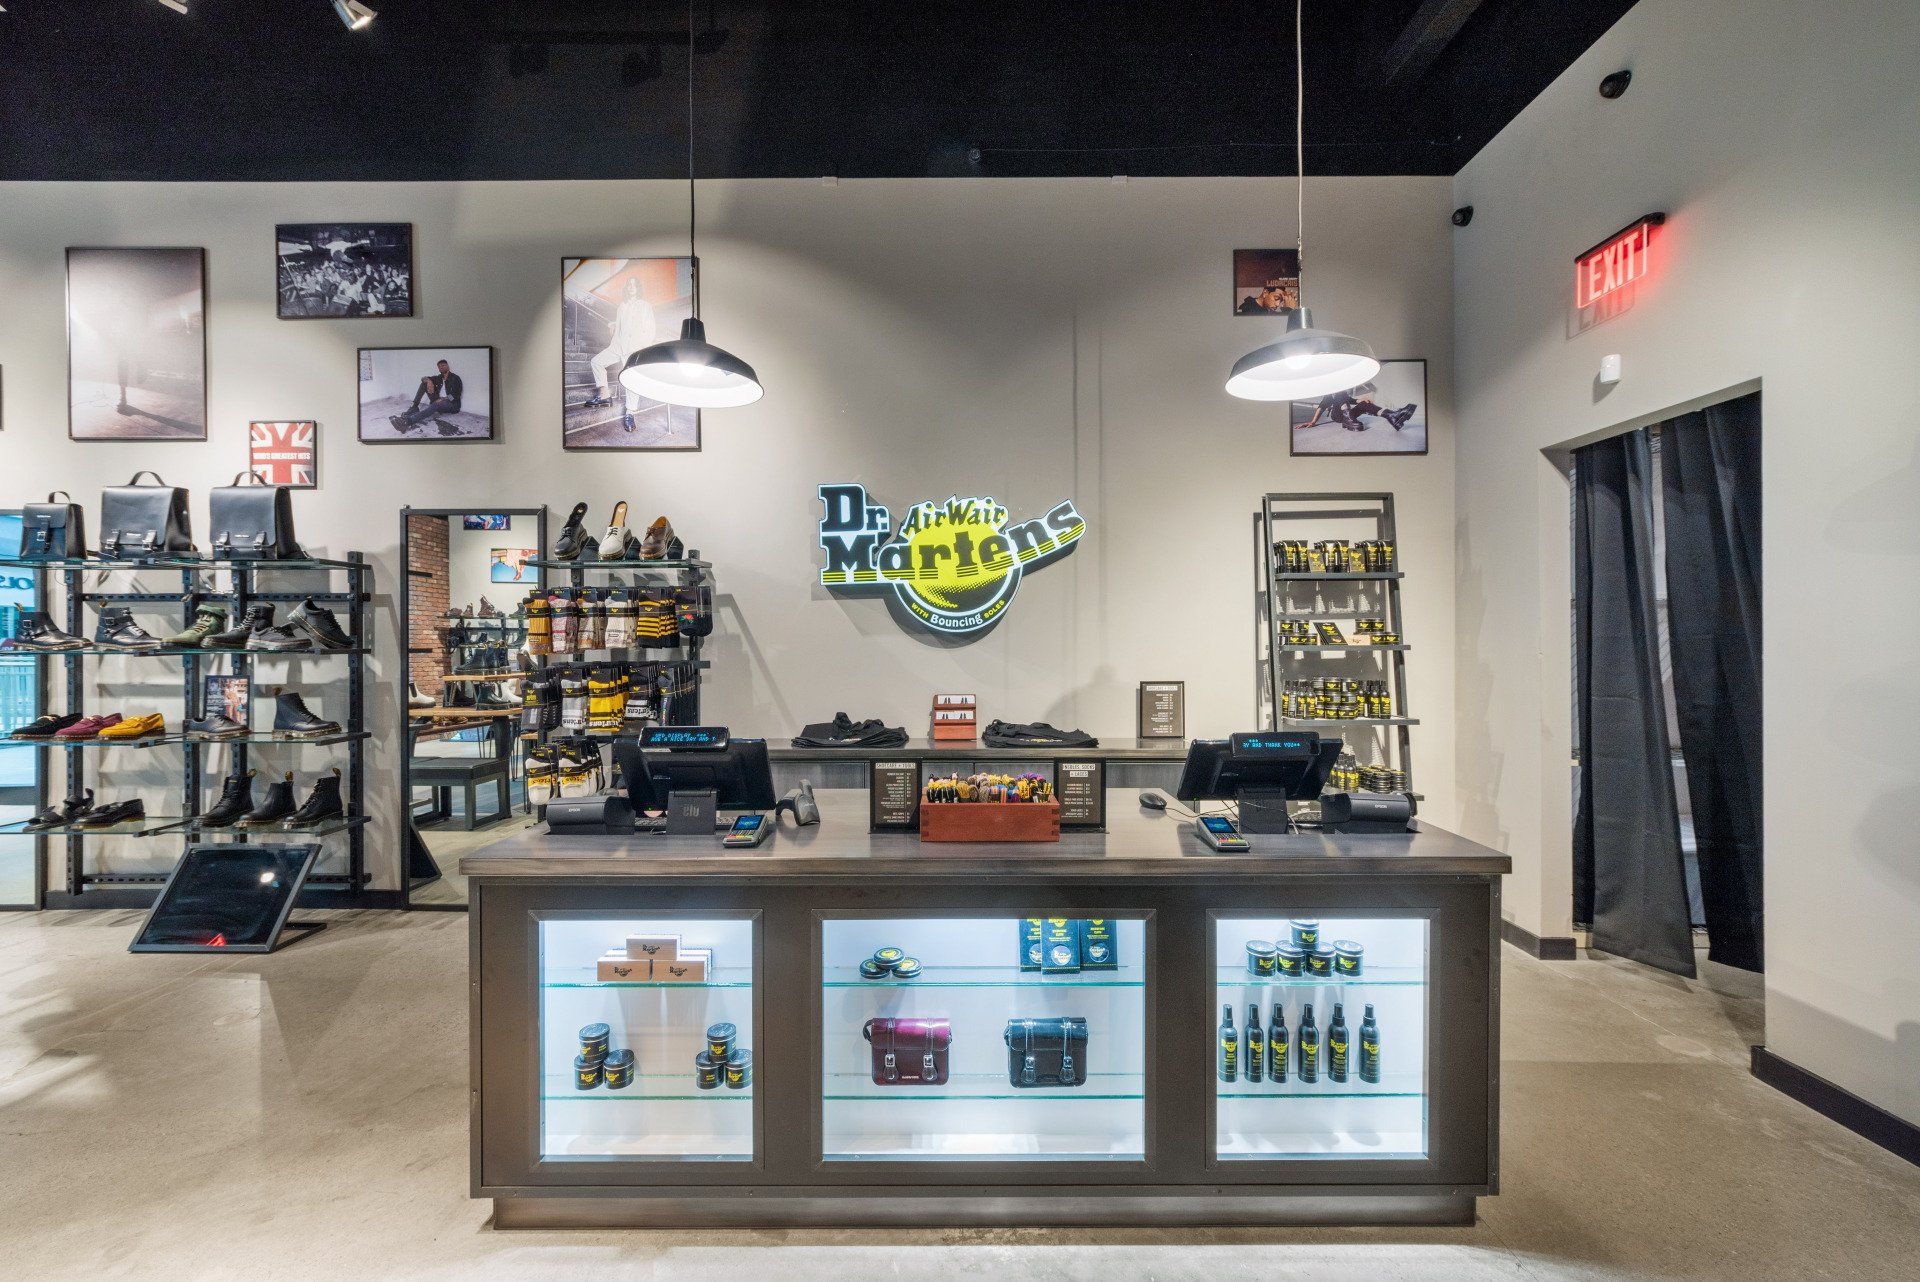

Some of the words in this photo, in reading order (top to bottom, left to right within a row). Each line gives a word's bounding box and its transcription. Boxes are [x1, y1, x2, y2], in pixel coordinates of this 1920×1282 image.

[1589, 232, 1638, 301] EXIT
[821, 485, 888, 532] Dr.
[904, 495, 1006, 535] AirWair
[822, 499, 1085, 582] Martens
[911, 602, 929, 619] WITH
[930, 612, 983, 629] Bouncing
[983, 599, 1006, 619] SOLES
